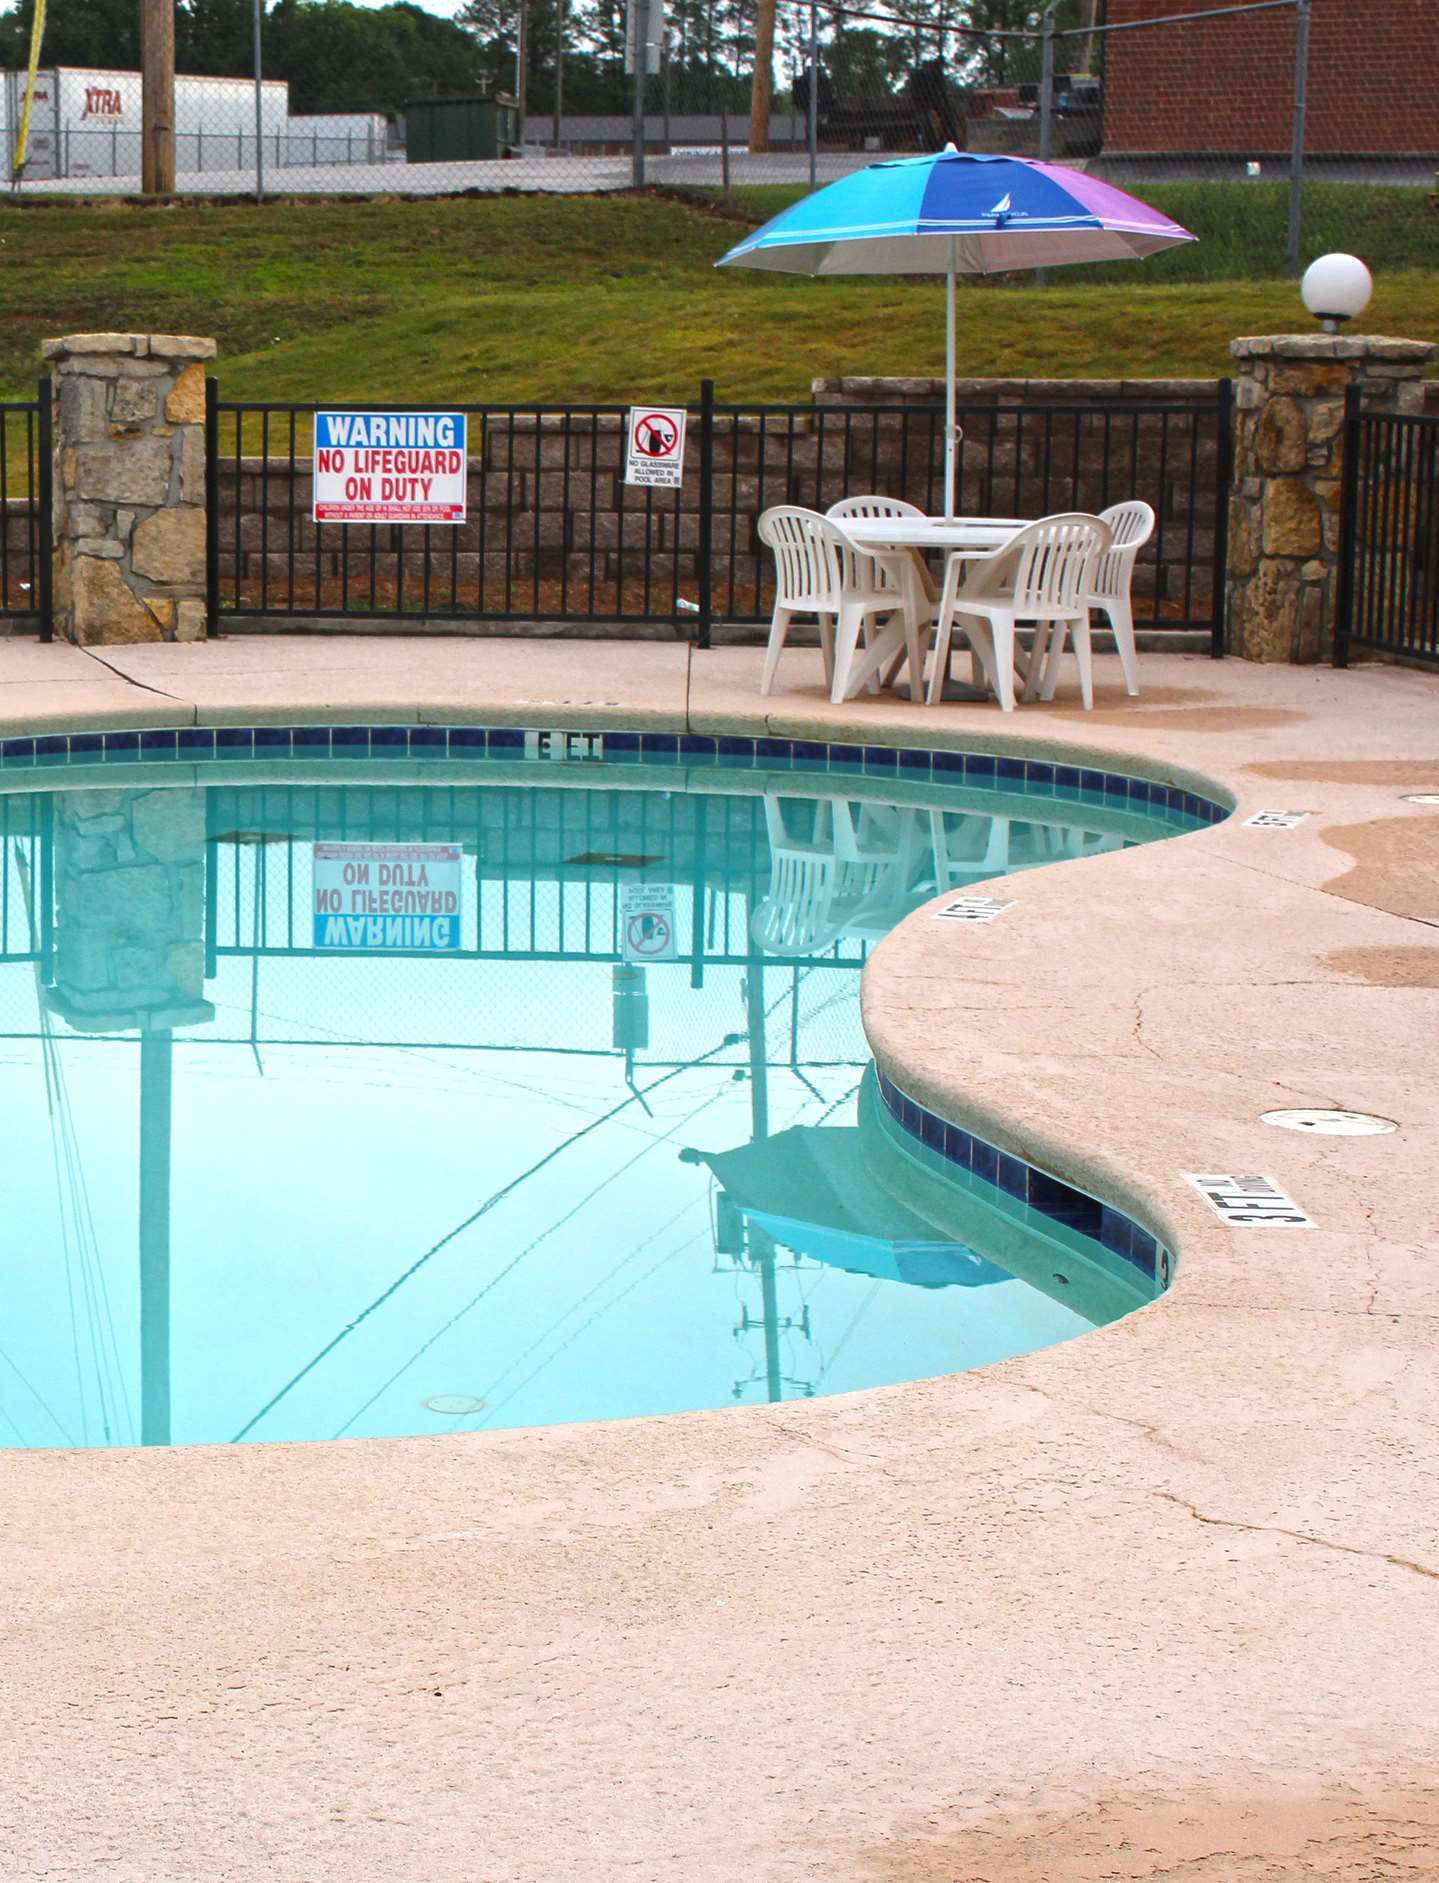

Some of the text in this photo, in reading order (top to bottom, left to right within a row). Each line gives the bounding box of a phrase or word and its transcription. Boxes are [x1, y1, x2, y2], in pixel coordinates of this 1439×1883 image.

[80, 86, 122, 121] XTRA
[326, 416, 455, 447] WARNING
[319, 449, 461, 474] NO LIFEGUARD
[634, 468, 665, 476] ALLOWED
[345, 477, 433, 501] ON DUTY
[654, 477, 672, 485] AREA
[1207, 1192, 1307, 1223] 3 FT
